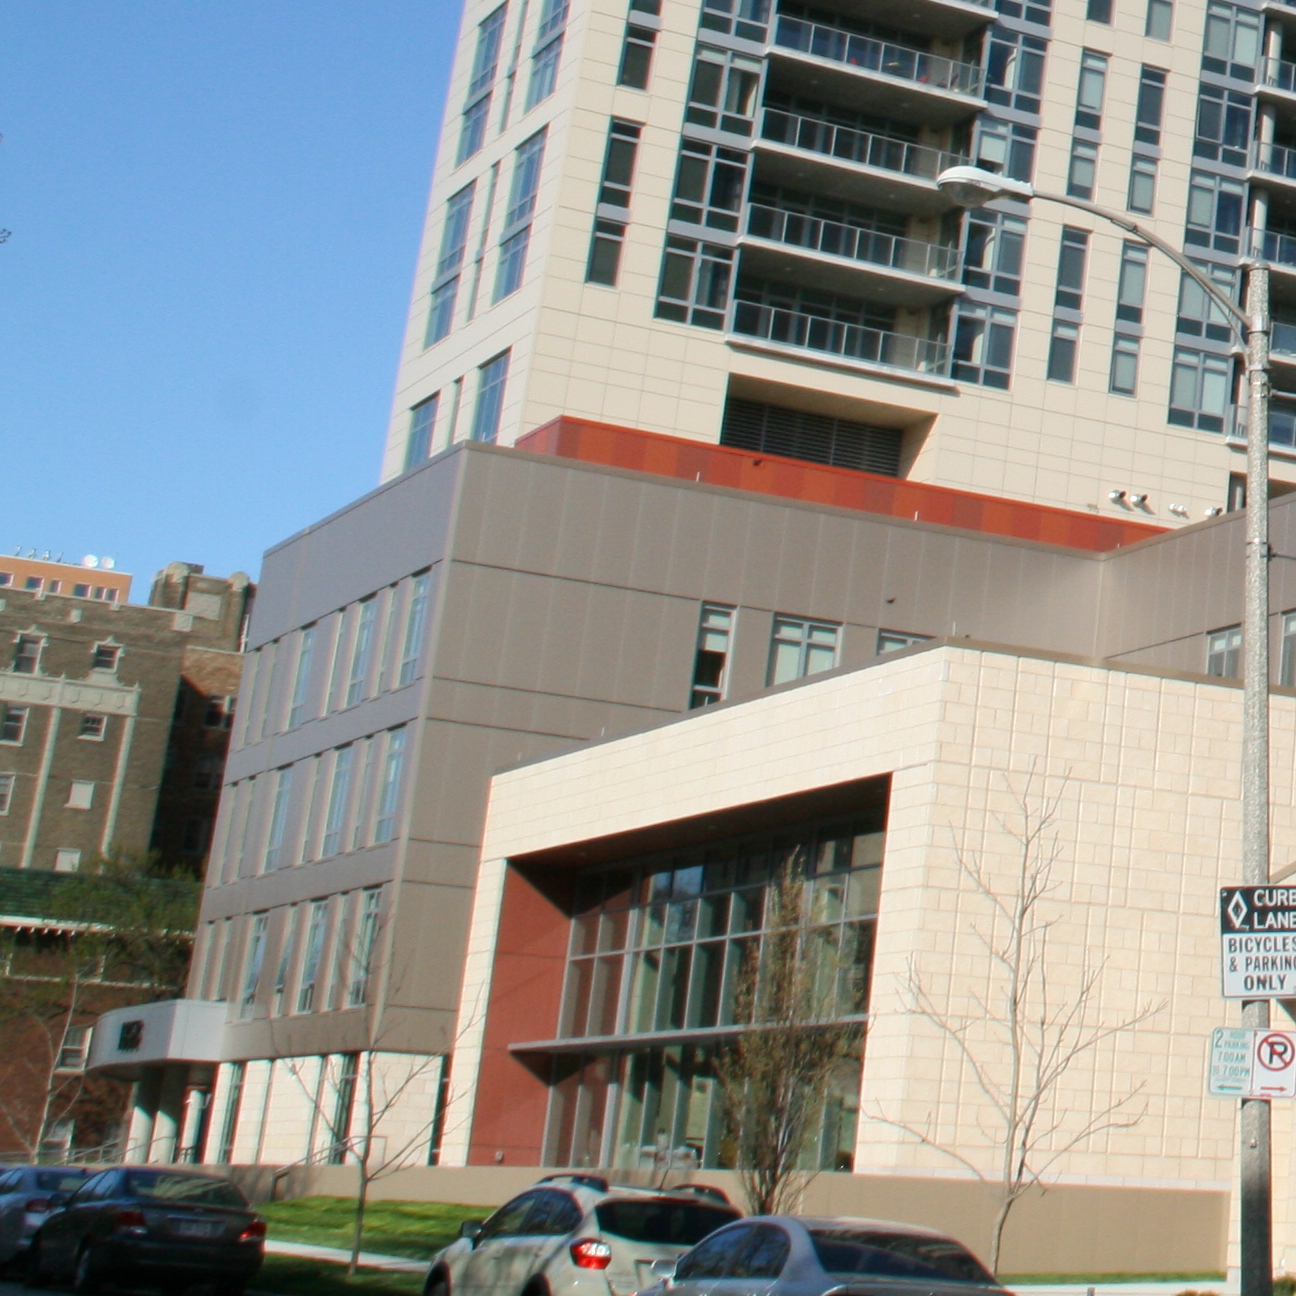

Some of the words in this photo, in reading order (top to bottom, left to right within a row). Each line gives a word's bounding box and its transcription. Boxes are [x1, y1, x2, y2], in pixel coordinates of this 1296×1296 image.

[1229, 956, 1238, 972] &
[1244, 974, 1287, 991] ONLY
[1214, 1029, 1224, 1049] 2
